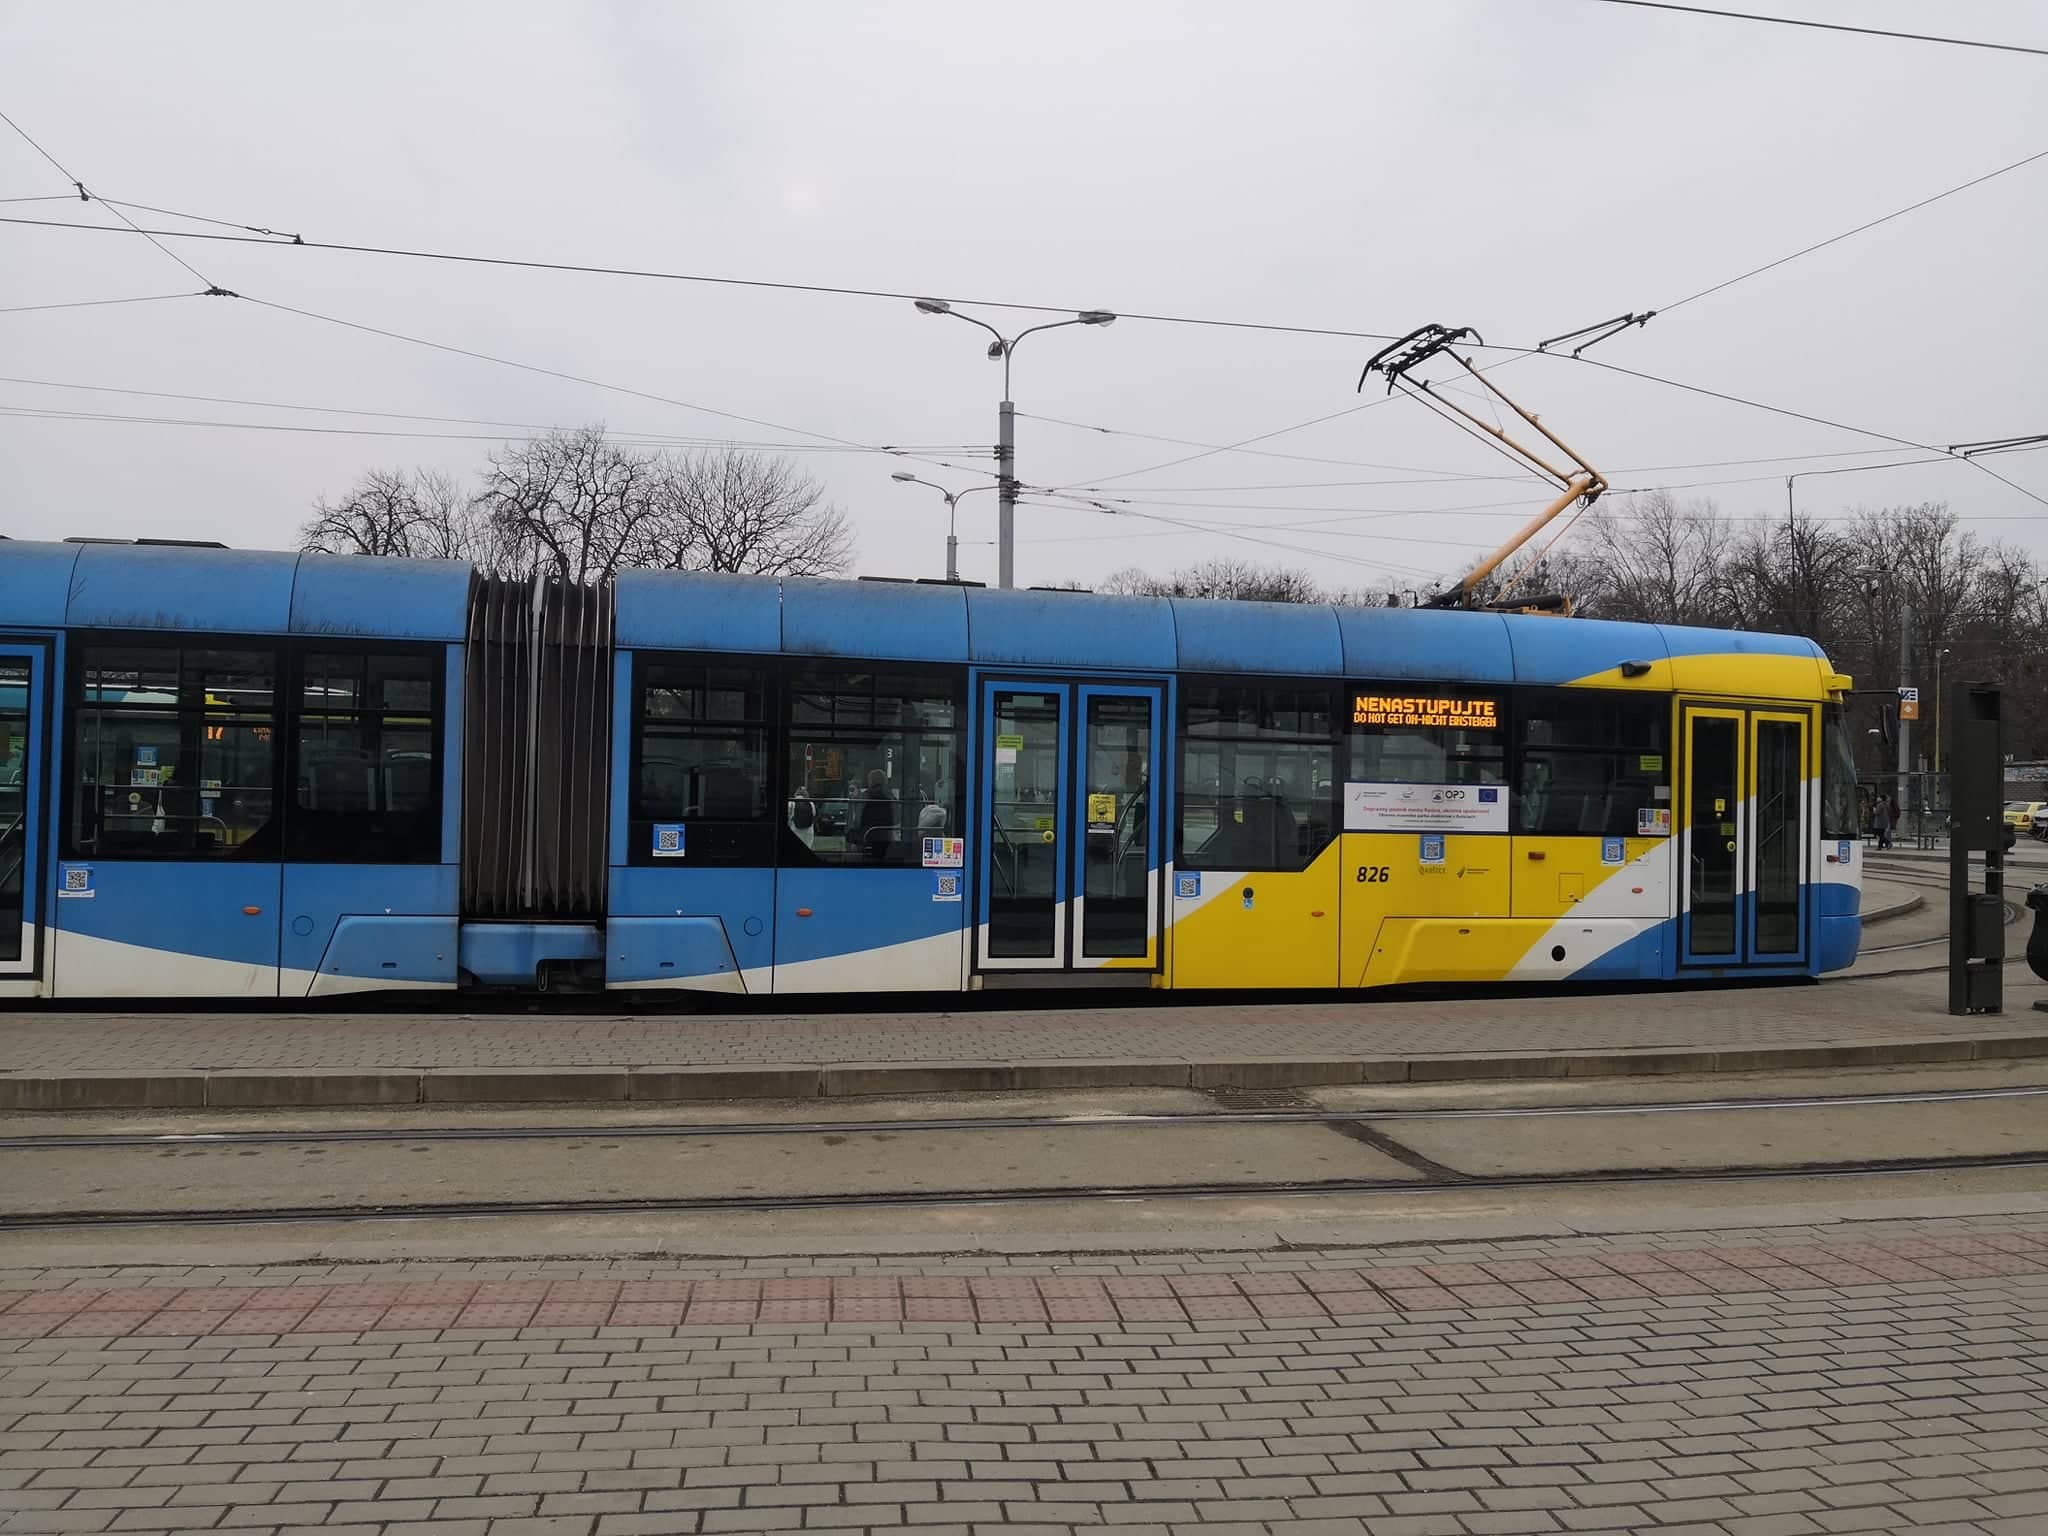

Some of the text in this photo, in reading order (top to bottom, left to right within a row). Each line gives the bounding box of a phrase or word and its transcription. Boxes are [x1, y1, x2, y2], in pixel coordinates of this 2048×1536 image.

[1356, 696, 1495, 716] NENASTUPUJTE
[1353, 712, 1366, 723] DO
[1368, 713, 1386, 724] NOT
[1387, 713, 1404, 725] GET
[1448, 716, 1497, 728] EINSTEIGEN
[1356, 866, 1389, 883] 826
